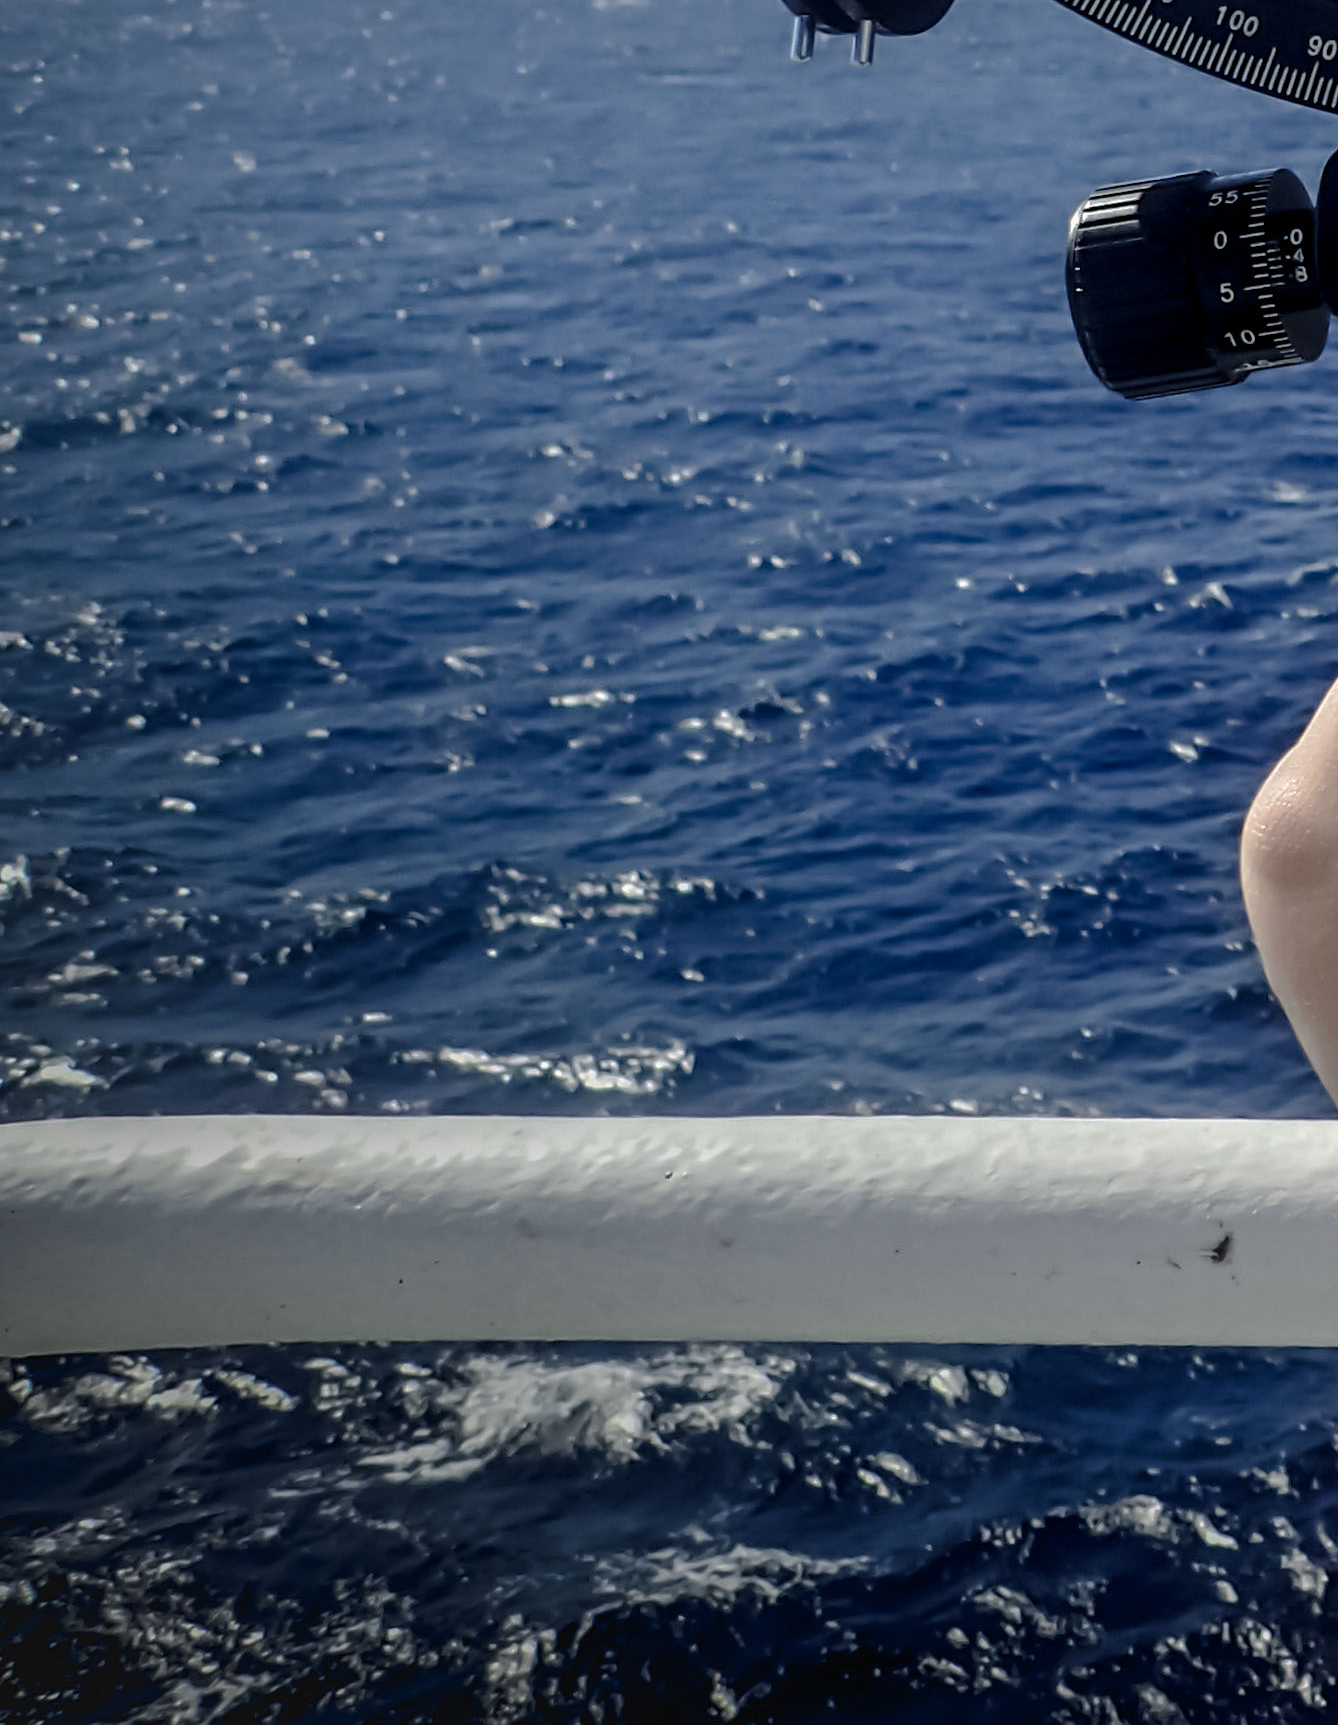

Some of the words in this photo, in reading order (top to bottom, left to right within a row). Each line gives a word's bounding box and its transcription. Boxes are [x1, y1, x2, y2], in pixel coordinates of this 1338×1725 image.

[1216, 5, 1260, 38] 100
[1308, 36, 1337, 60] 90
[1209, 191, 1238, 206] 55
[1214, 231, 1227, 249] 0
[1290, 229, 1303, 245] 0
[1221, 283, 1234, 302] 5
[1224, 329, 1256, 347] 10
